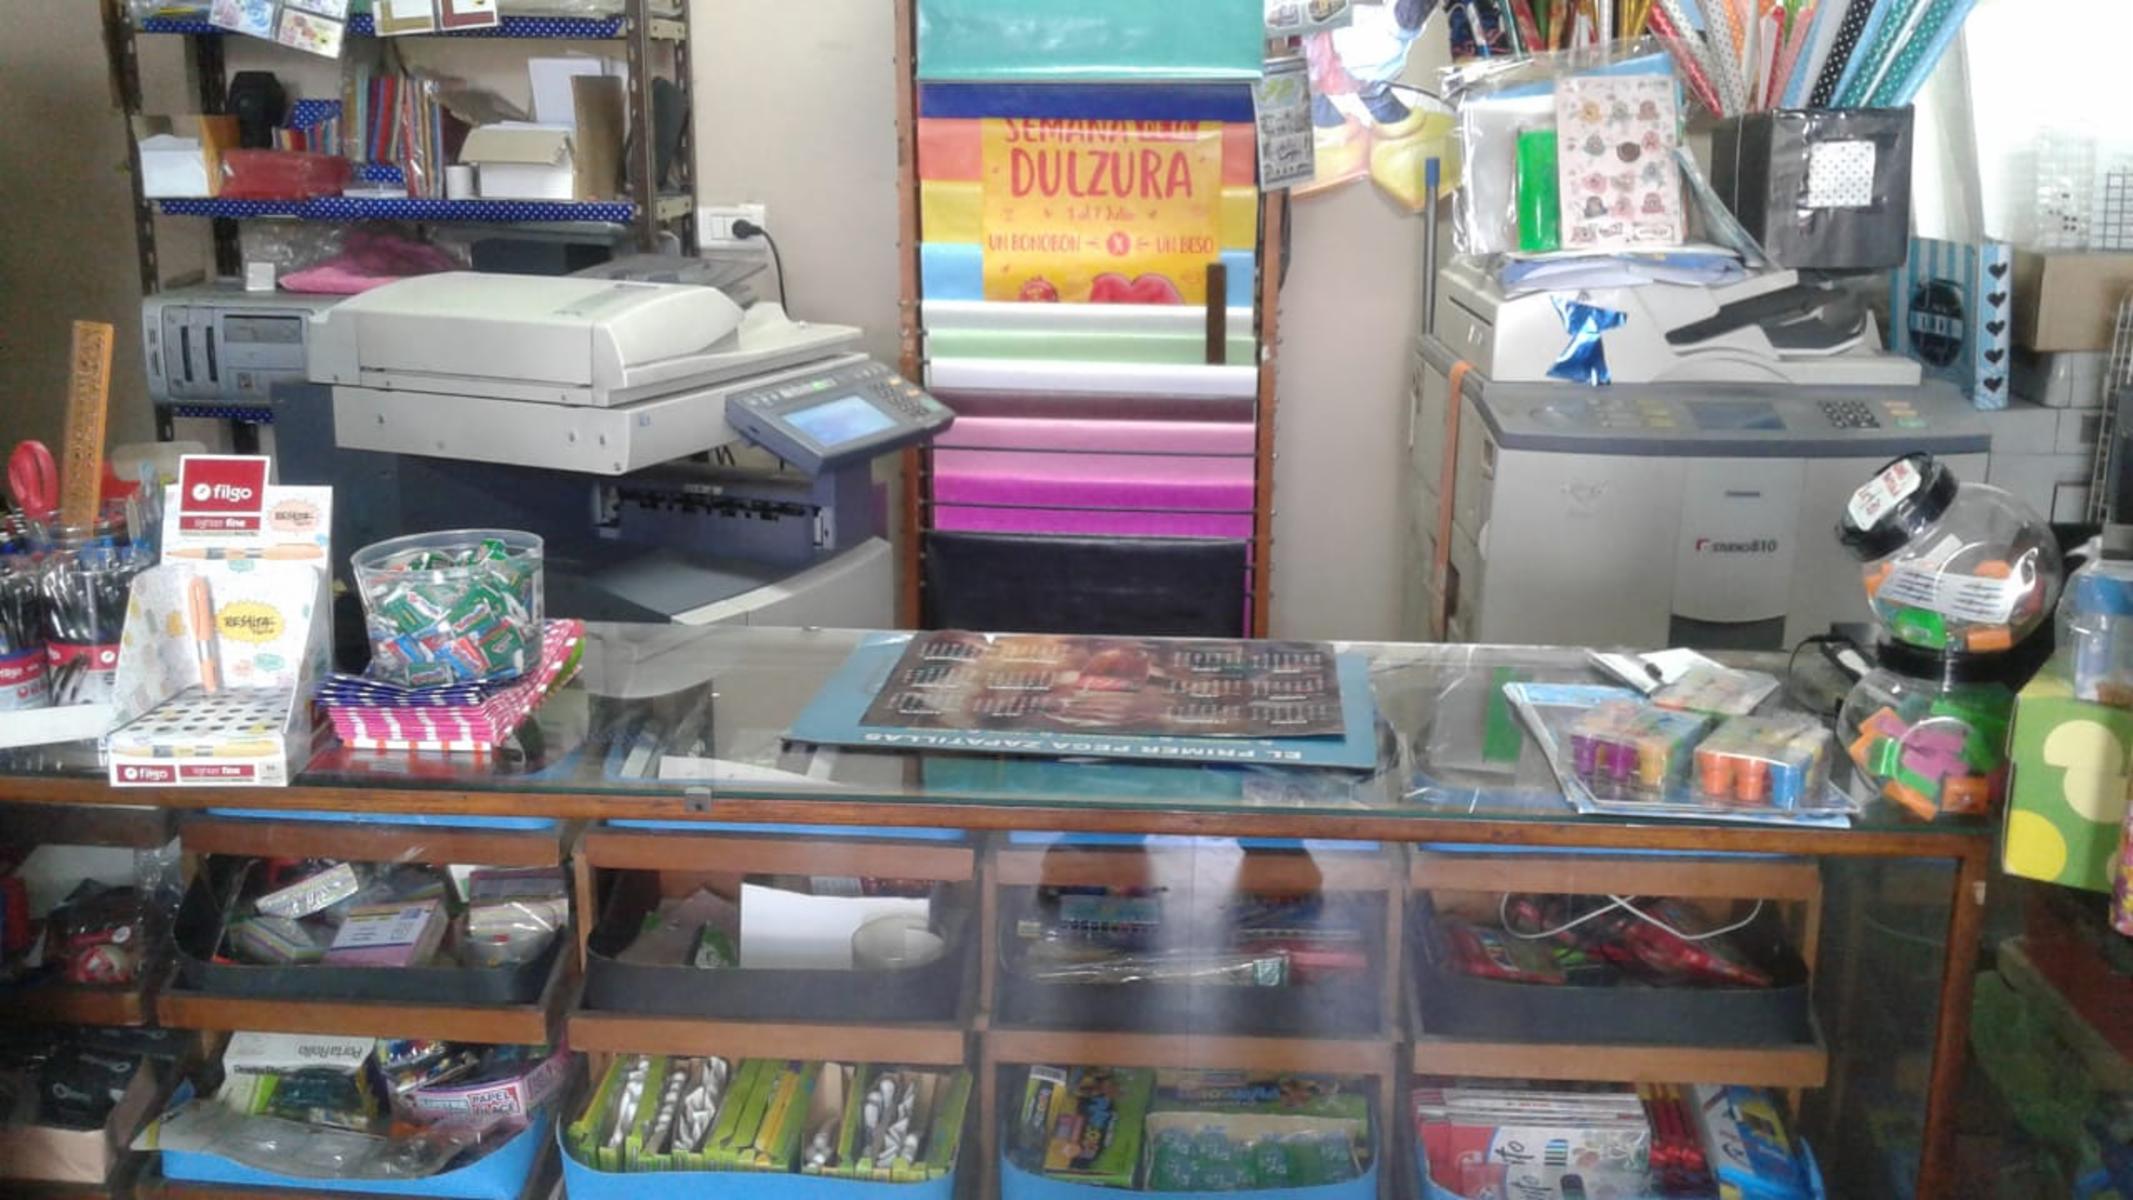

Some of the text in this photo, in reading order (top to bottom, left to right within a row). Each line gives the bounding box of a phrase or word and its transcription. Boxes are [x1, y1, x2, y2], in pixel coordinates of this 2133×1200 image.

[1010, 147, 1193, 199] DULZURA
[213, 483, 253, 503] filgo
[225, 517, 247, 528] fine
[863, 732, 1043, 750] ZAPATILLAS
[1052, 739, 1135, 753] PEGA
[1140, 743, 1256, 758] PRIMER
[1267, 748, 1302, 759] EL
[139, 767, 169, 781] filgo
